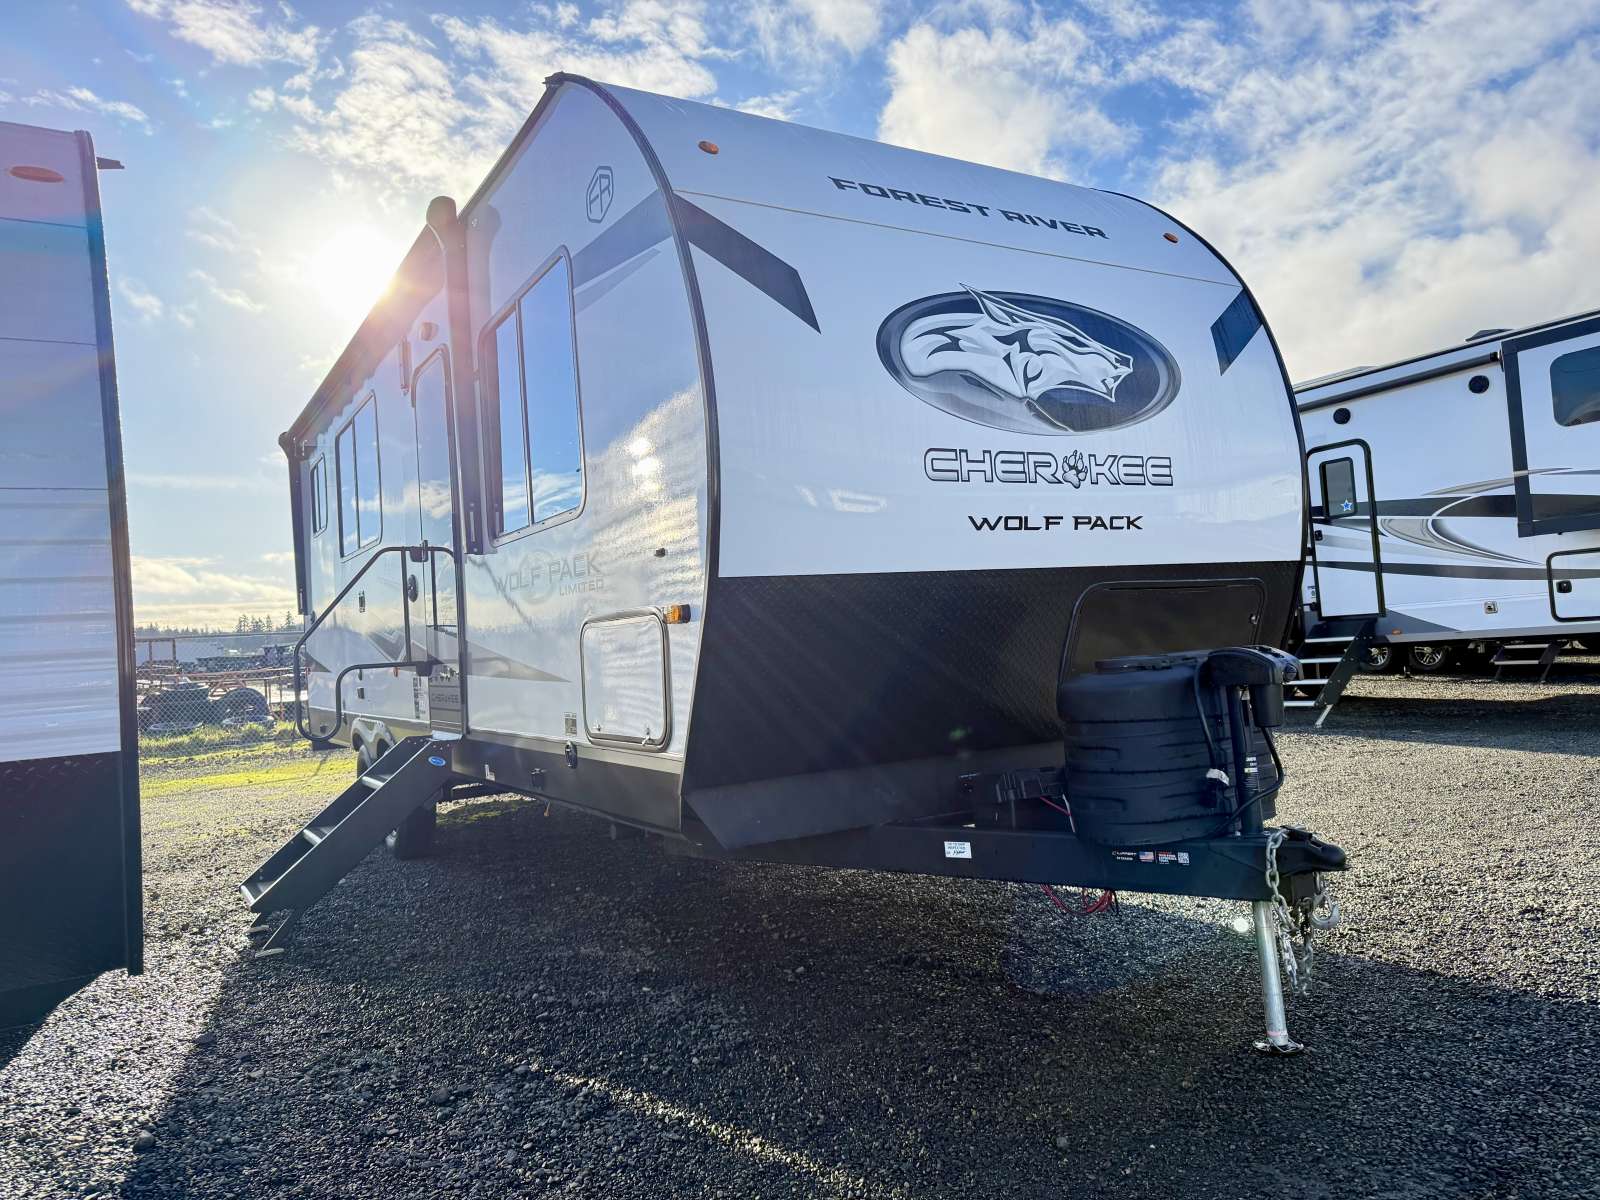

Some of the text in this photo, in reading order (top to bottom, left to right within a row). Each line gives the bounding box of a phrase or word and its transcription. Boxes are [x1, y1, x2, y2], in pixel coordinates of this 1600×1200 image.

[828, 176, 1110, 240] FOREST RIVER
[968, 515, 1143, 531] WOLF PACK
[497, 550, 601, 593] WOLF PACK
[559, 576, 604, 597] LIMITED
